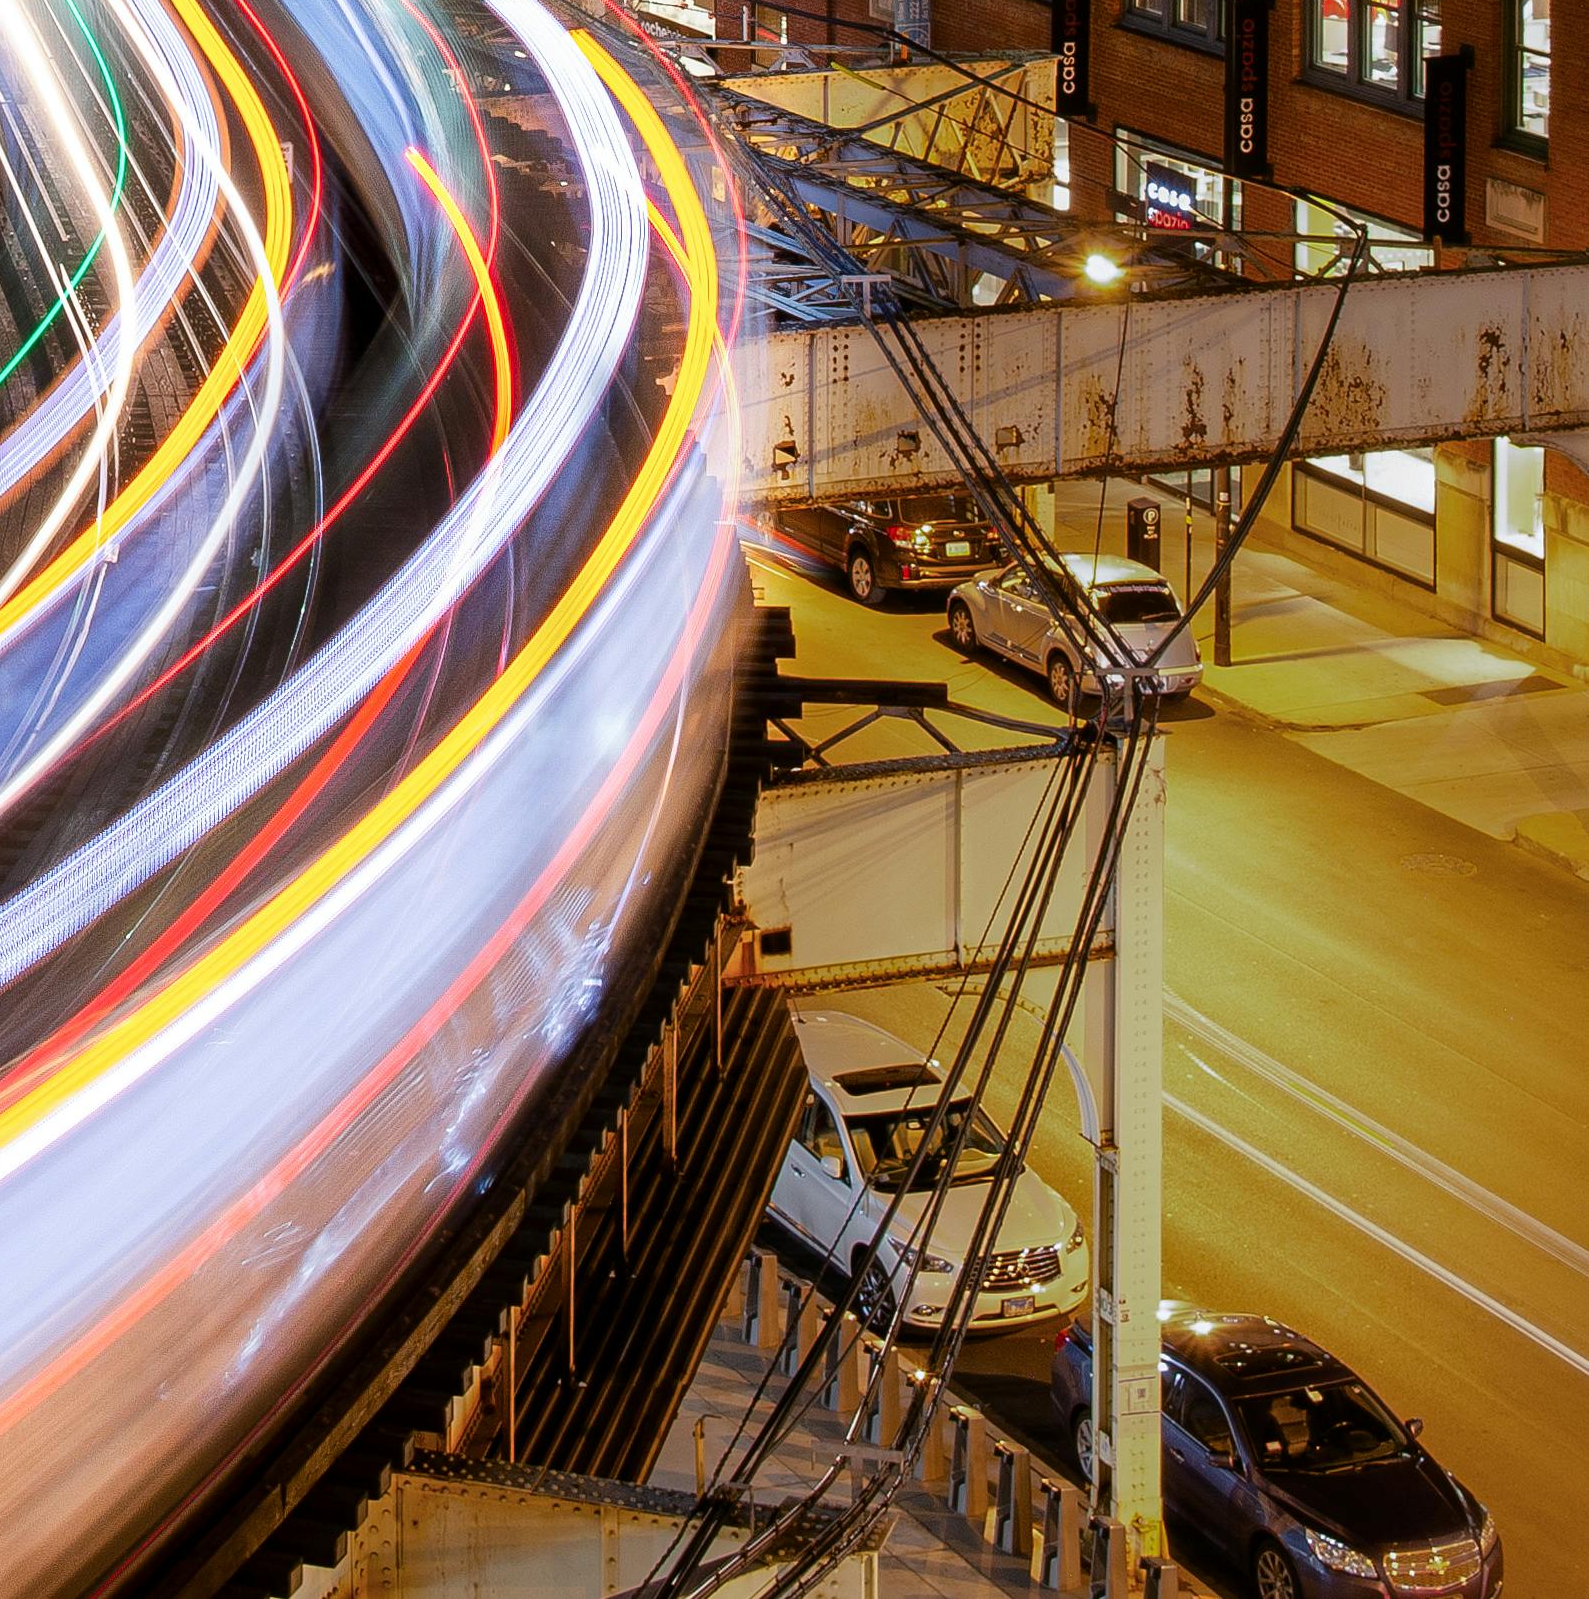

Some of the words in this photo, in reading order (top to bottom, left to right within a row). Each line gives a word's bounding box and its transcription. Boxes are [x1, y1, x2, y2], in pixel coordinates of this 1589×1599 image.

[1062, 41, 1076, 94] casa
[1236, 18, 1259, 92] spazio
[1240, 97, 1254, 153] casa
[1147, 182, 1191, 211] casa
[1436, 164, 1451, 223] casa
